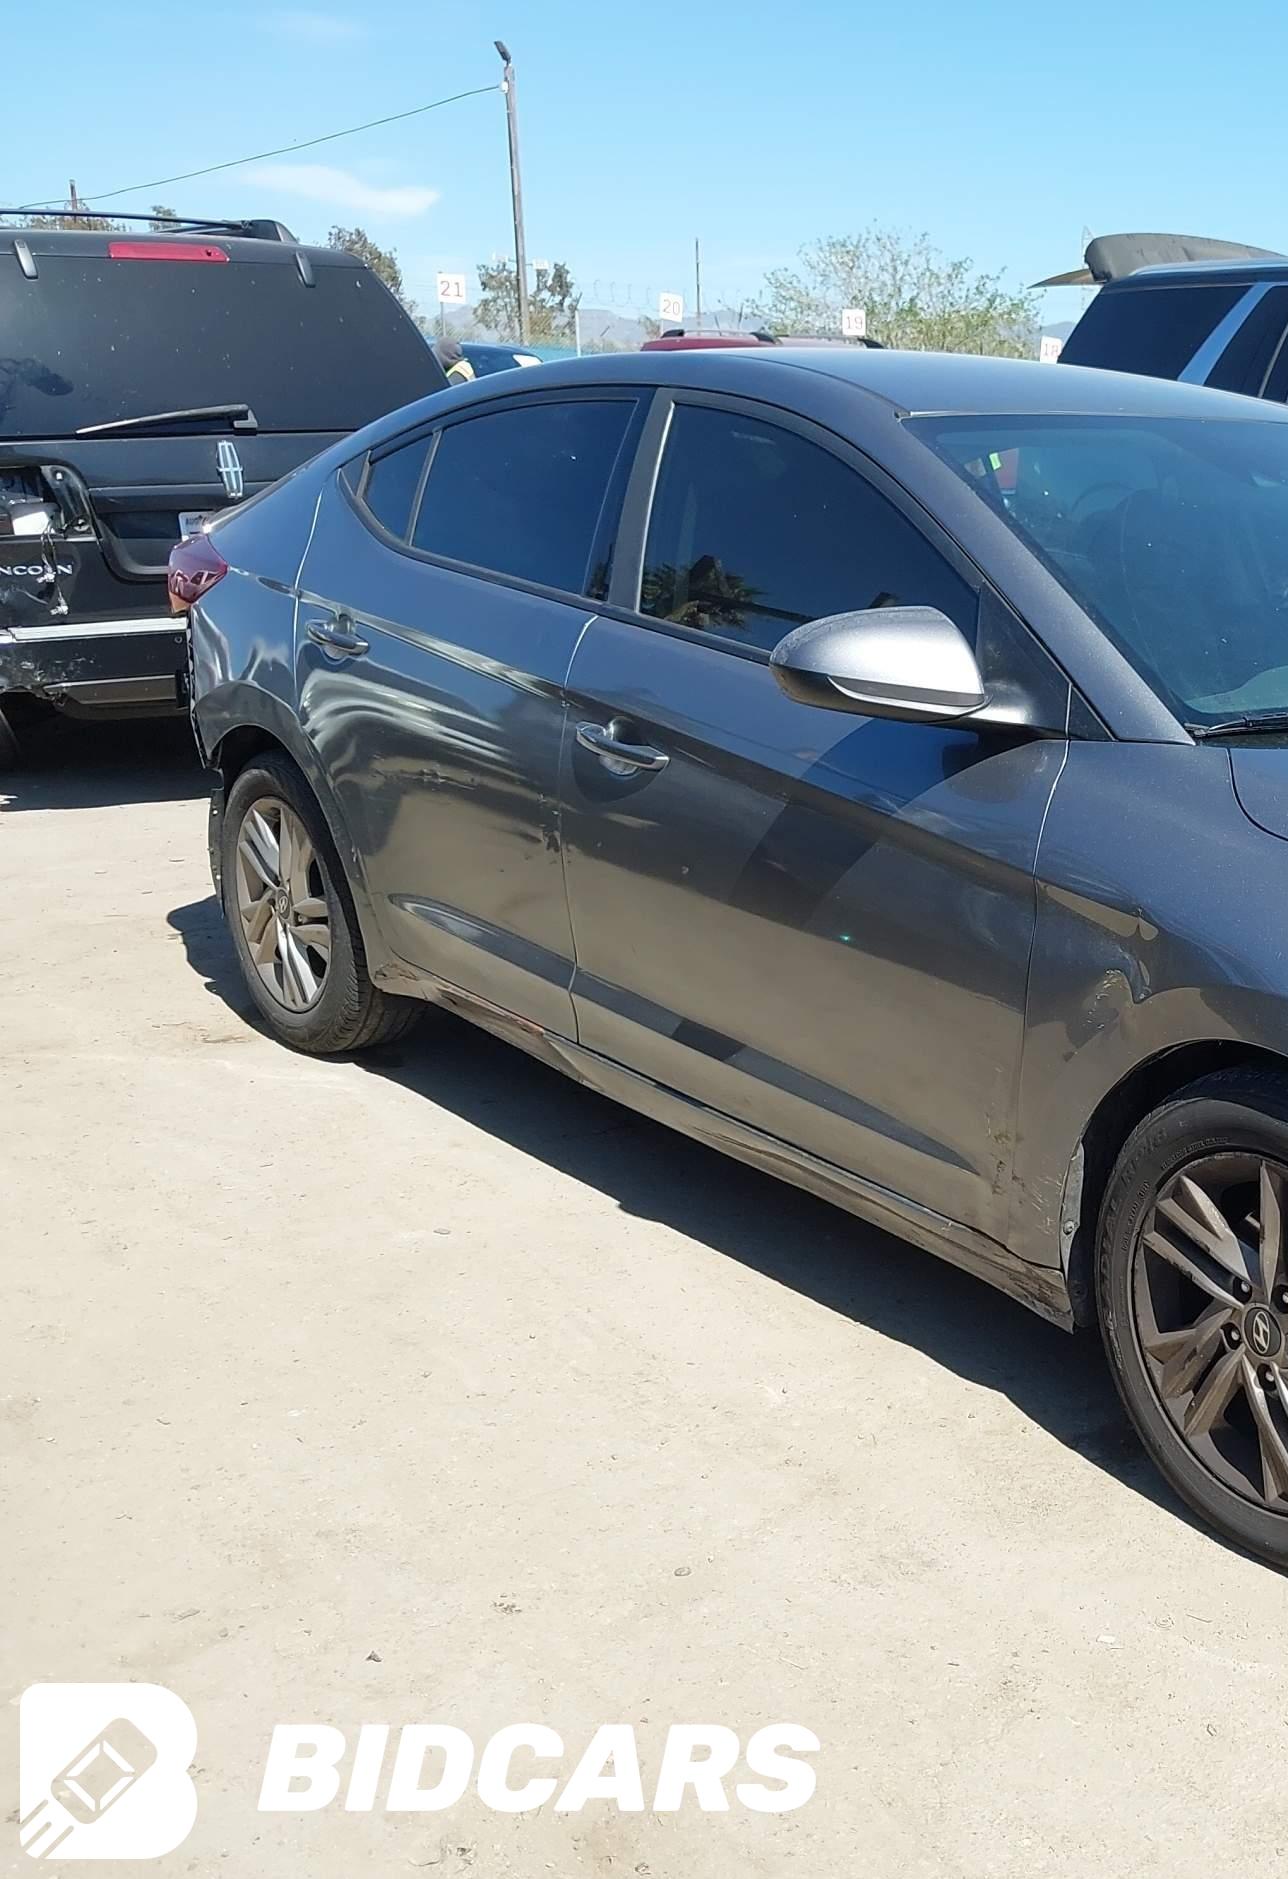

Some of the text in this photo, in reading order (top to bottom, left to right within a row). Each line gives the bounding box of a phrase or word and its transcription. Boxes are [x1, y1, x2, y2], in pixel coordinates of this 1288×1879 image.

[440, 280, 463, 297] 21
[663, 298, 680, 316] 20
[846, 316, 863, 329] 19
[0, 564, 73, 576] NCON
